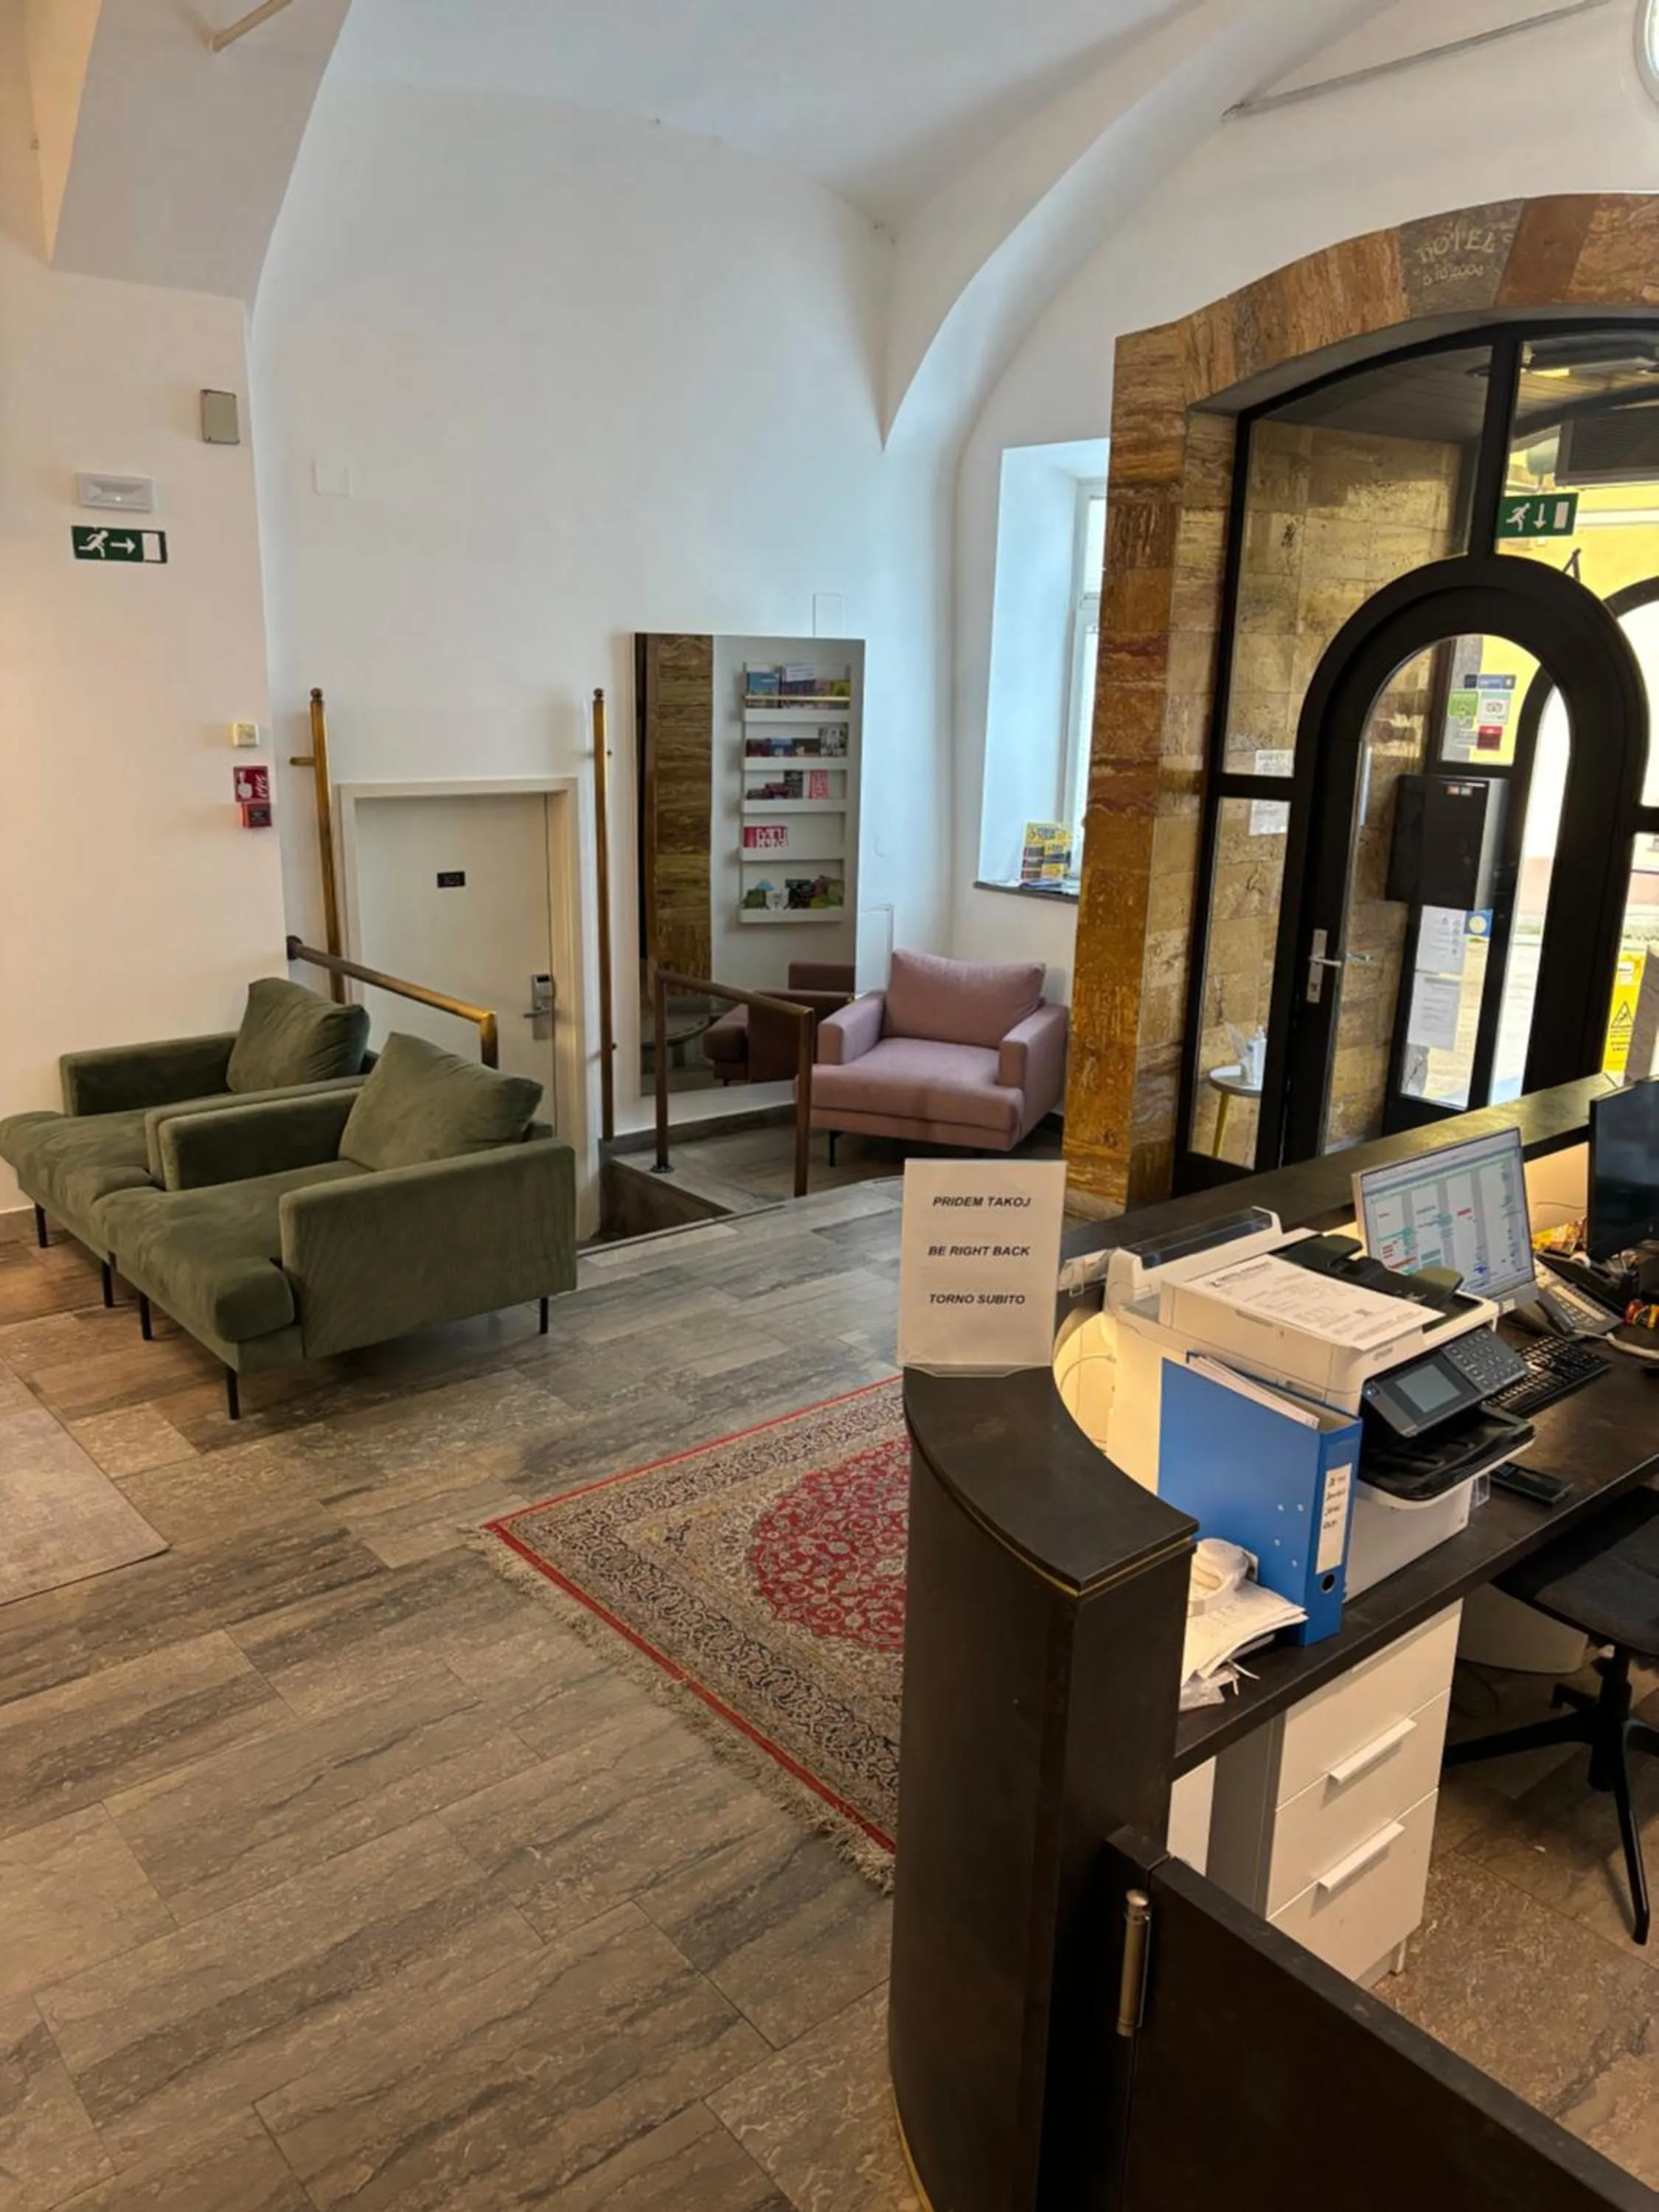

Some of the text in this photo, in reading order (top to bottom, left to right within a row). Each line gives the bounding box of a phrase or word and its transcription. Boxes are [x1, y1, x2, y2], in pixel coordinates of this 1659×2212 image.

[932, 1196, 1032, 1207] PRIDEM TAKOJ
[928, 1245, 1030, 1256] BE RIGHT BACK
[930, 1293, 1026, 1305] TORNO SUBITO
